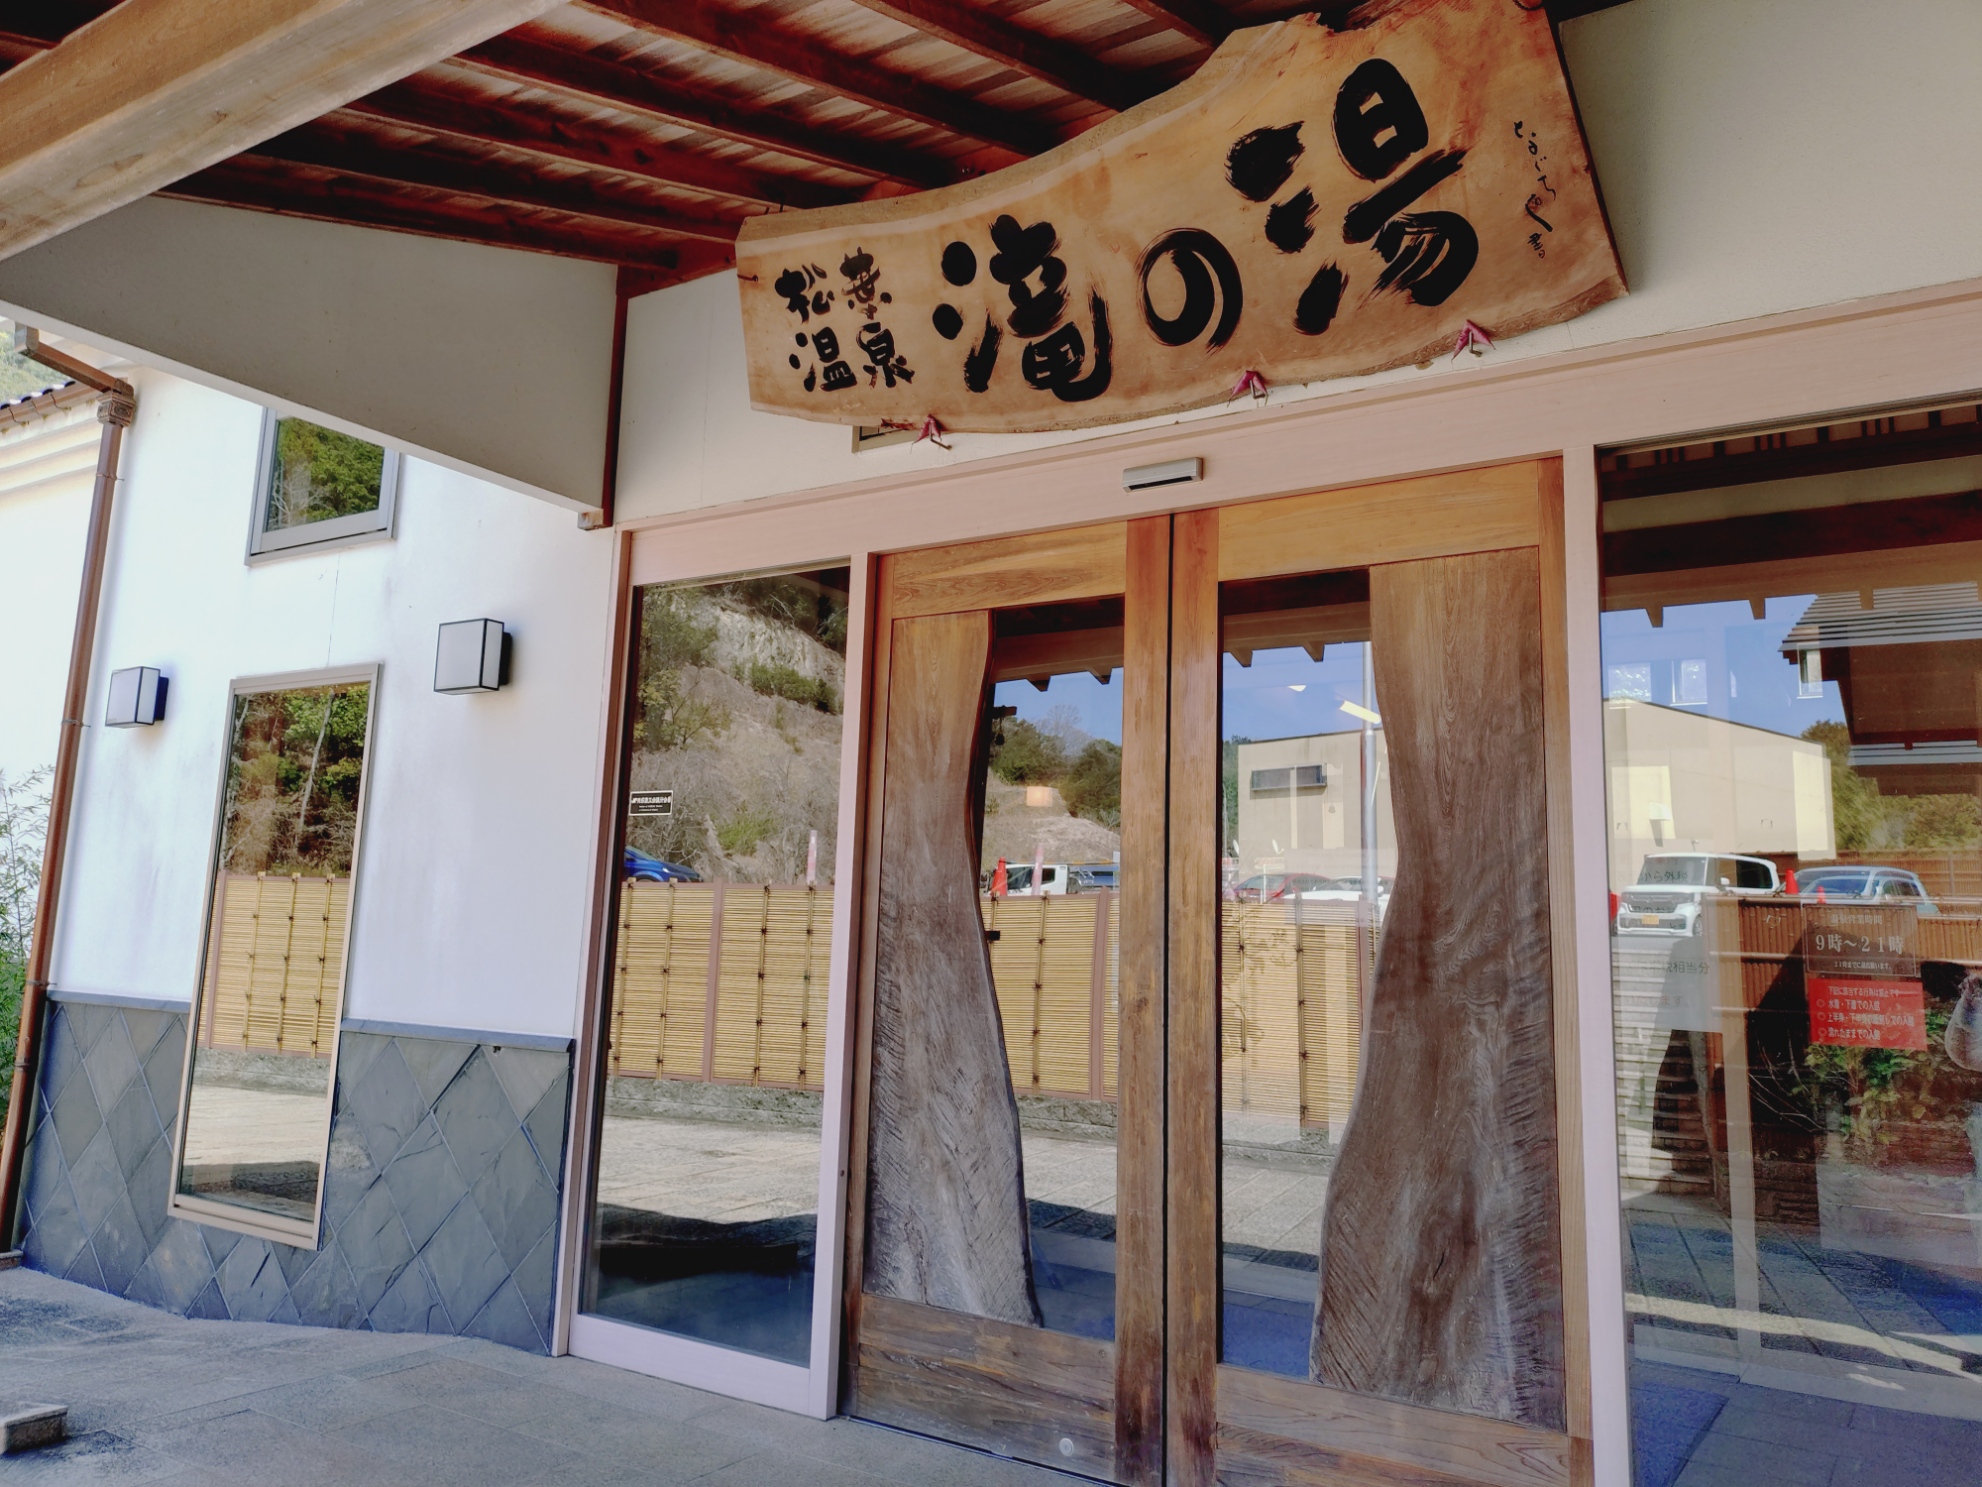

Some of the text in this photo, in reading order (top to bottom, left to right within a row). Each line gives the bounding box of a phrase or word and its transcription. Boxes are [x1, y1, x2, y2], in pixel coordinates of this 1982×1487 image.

[930, 58, 1480, 402] 滝の湯
[788, 321, 915, 393] 温泉
